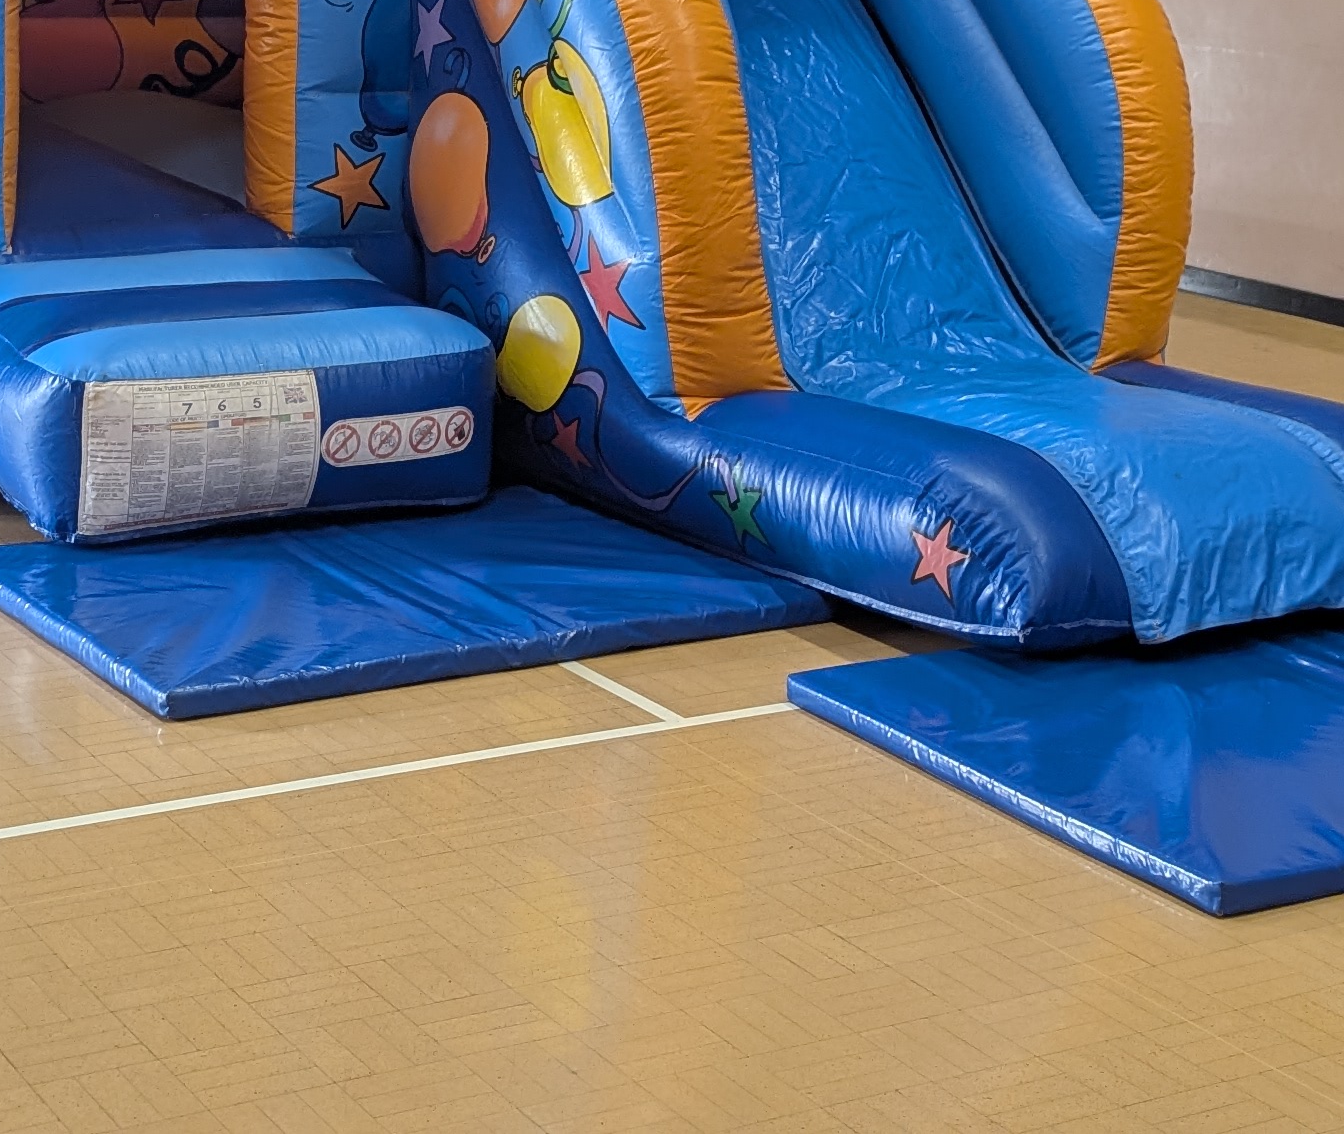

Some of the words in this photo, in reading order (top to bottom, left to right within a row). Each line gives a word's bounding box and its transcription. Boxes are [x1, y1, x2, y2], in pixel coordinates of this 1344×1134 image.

[181, 402, 193, 415] 7
[217, 399, 227, 412] 6
[252, 397, 262, 409] 5
